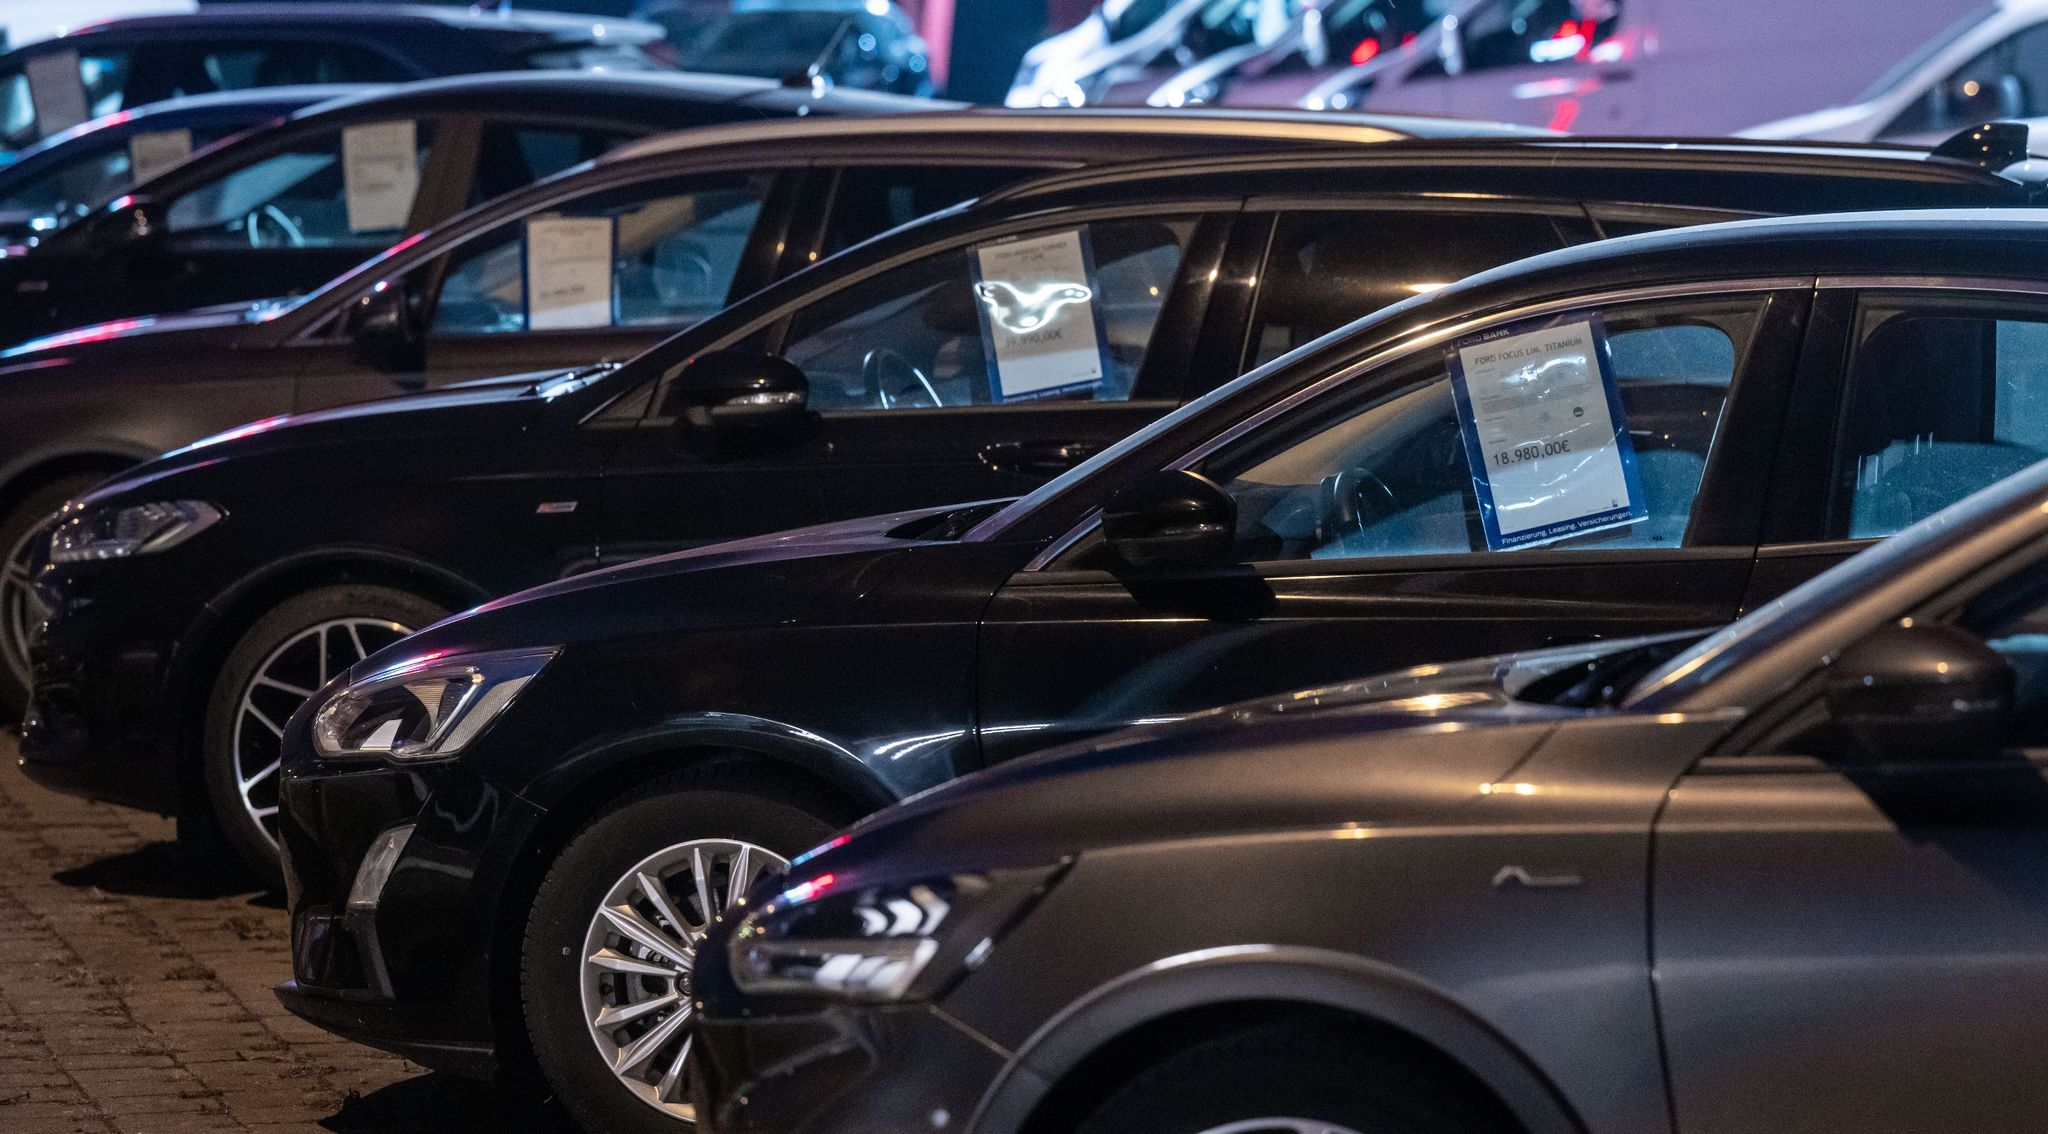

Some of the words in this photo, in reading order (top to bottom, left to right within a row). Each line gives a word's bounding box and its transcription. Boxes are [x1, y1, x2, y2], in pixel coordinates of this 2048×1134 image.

[1482, 329, 1510, 340] BANK
[1474, 354, 1496, 366] FORD
[1498, 348, 1524, 361] FOCUS
[1544, 337, 1583, 352] TITANIUM
[1493, 440, 1571, 466] 18.980,00€
